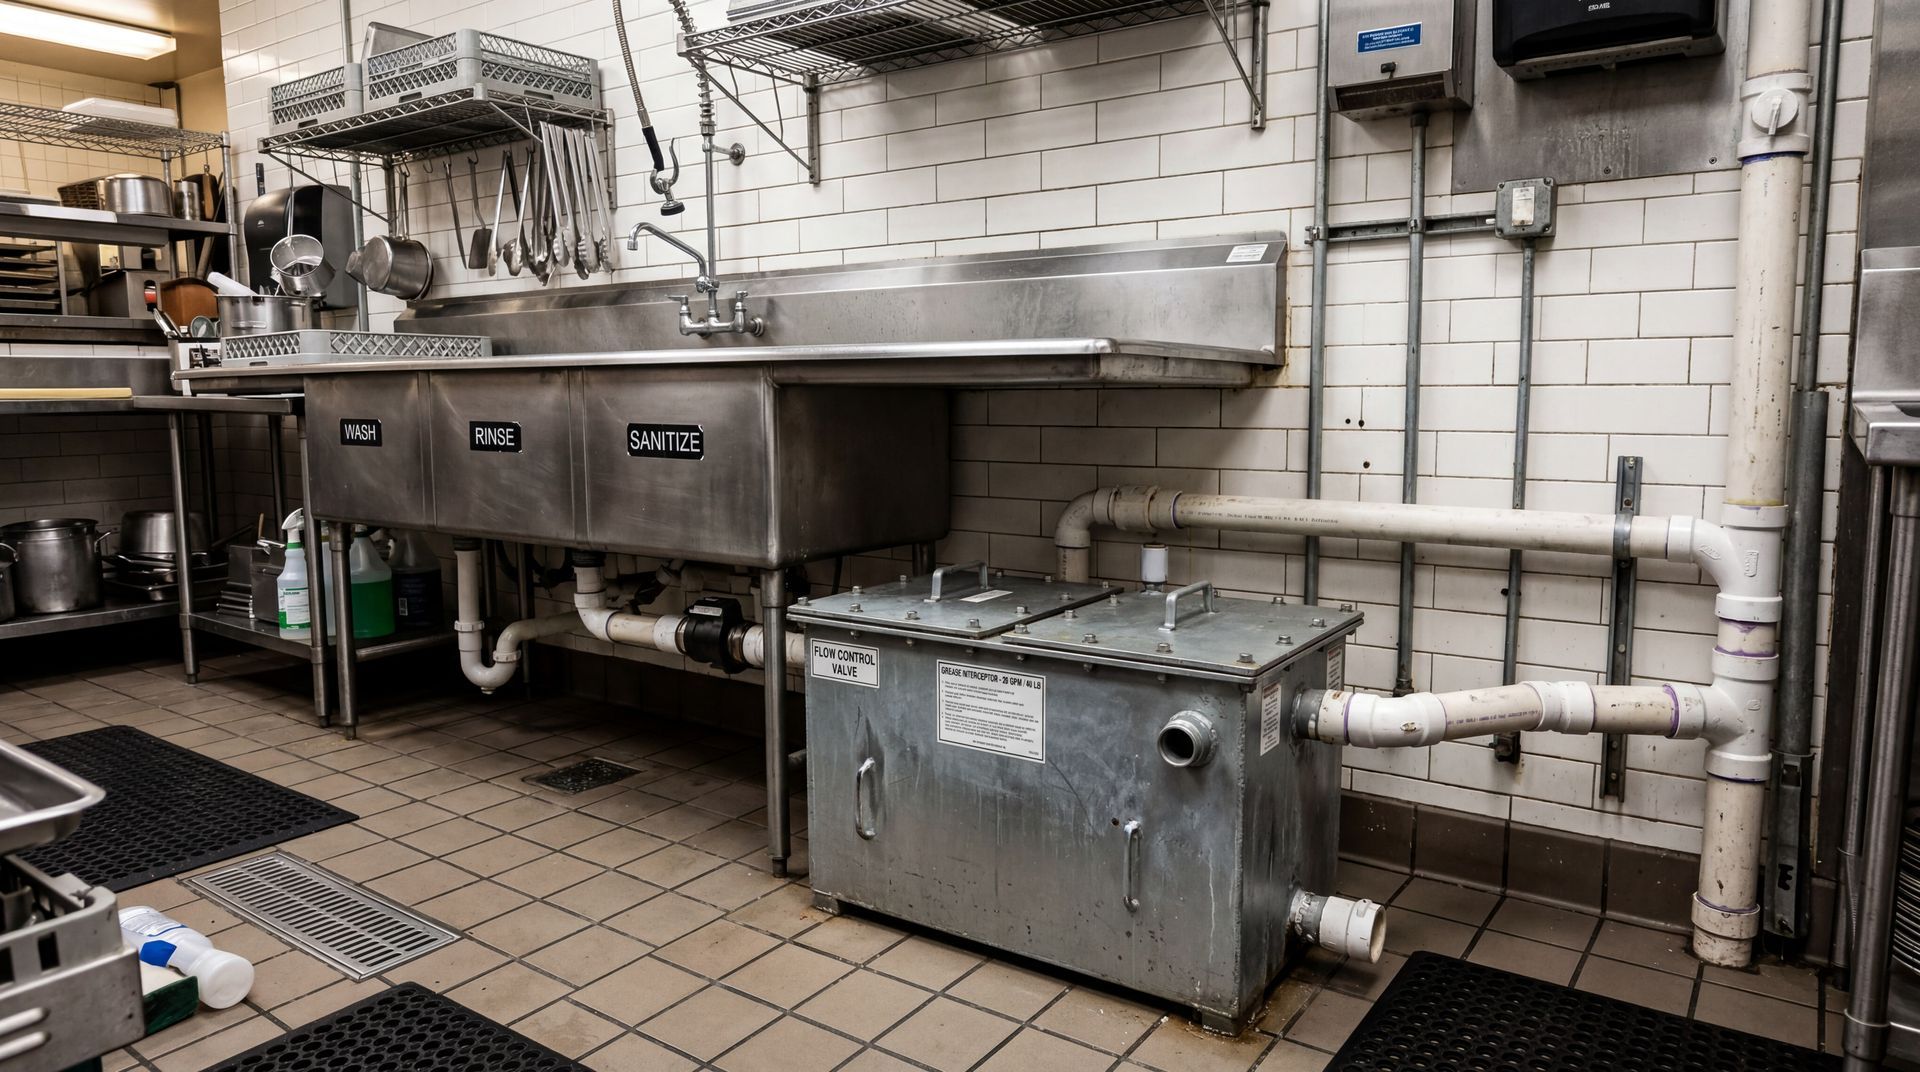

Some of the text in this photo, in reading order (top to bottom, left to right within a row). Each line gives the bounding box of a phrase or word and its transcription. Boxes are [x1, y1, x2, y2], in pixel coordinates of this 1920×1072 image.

[344, 424, 376, 441] WASH
[475, 427, 515, 446] RINSE
[630, 430, 700, 452] SANITIZE
[814, 646, 876, 666] FLOW CONTROL
[832, 663, 858, 678] VALVE
[941, 666, 961, 677] GREASE
[962, 670, 999, 682] INTERCEPTOR
[1010, 677, 1022, 686] GPM
